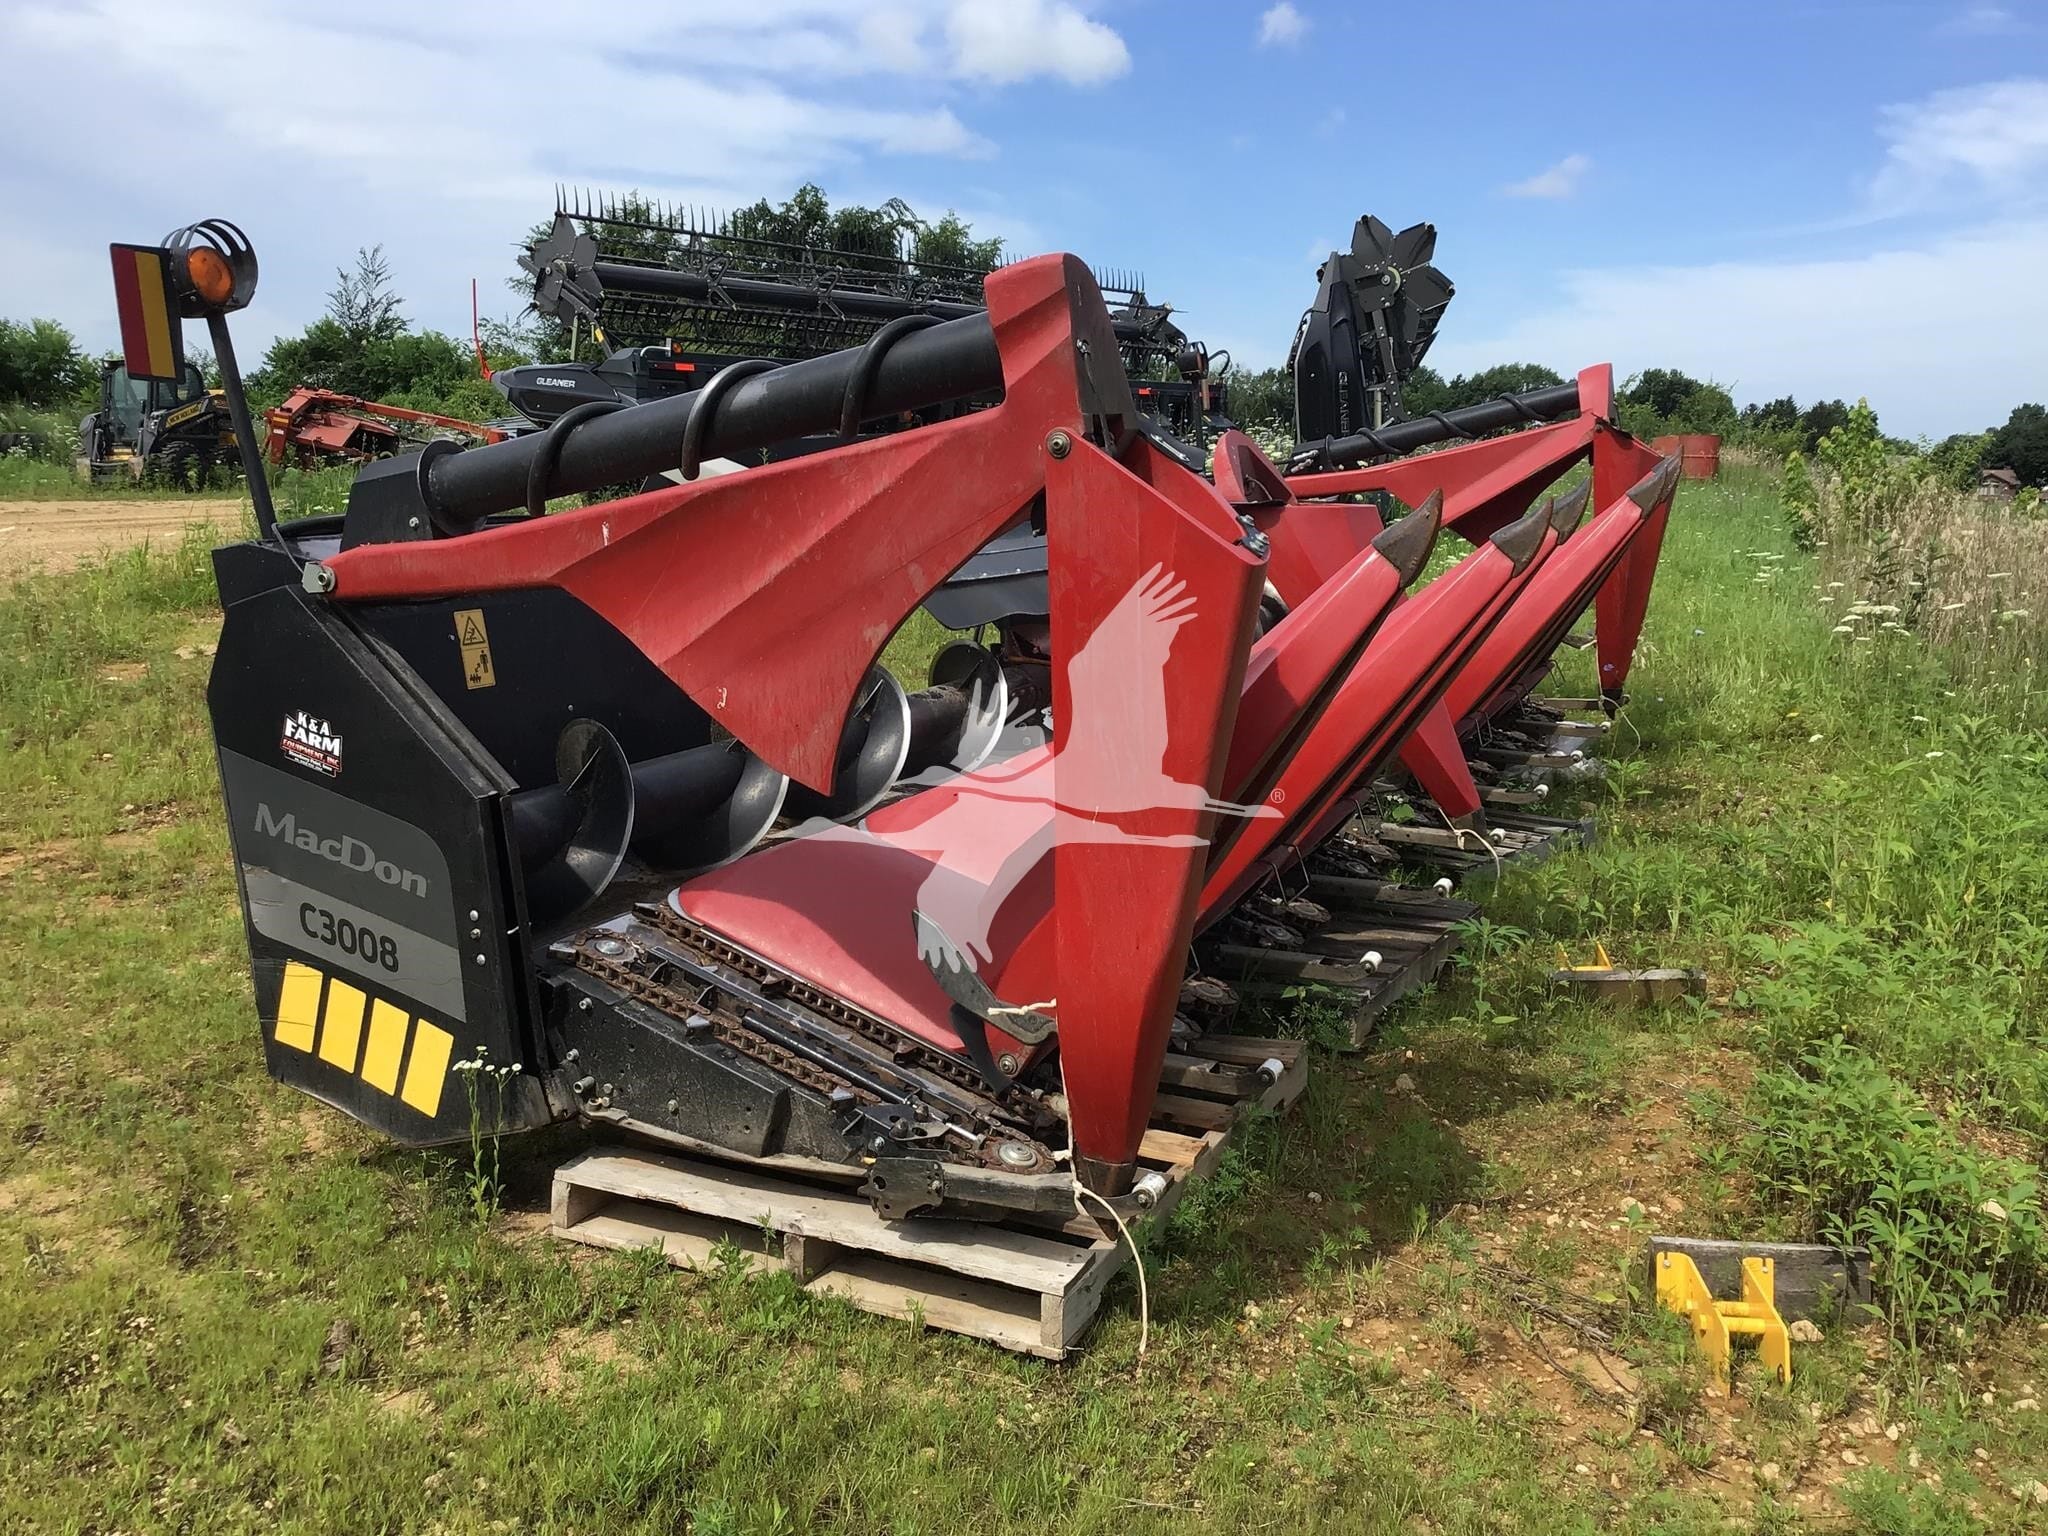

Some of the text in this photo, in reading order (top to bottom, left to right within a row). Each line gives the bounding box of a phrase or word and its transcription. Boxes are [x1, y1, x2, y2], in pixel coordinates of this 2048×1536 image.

[536, 377, 576, 388] GLEANER
[284, 717, 341, 756] FARM
[297, 711, 330, 736] K & A
[254, 803, 428, 898] MacDon
[299, 902, 399, 973] C3008
